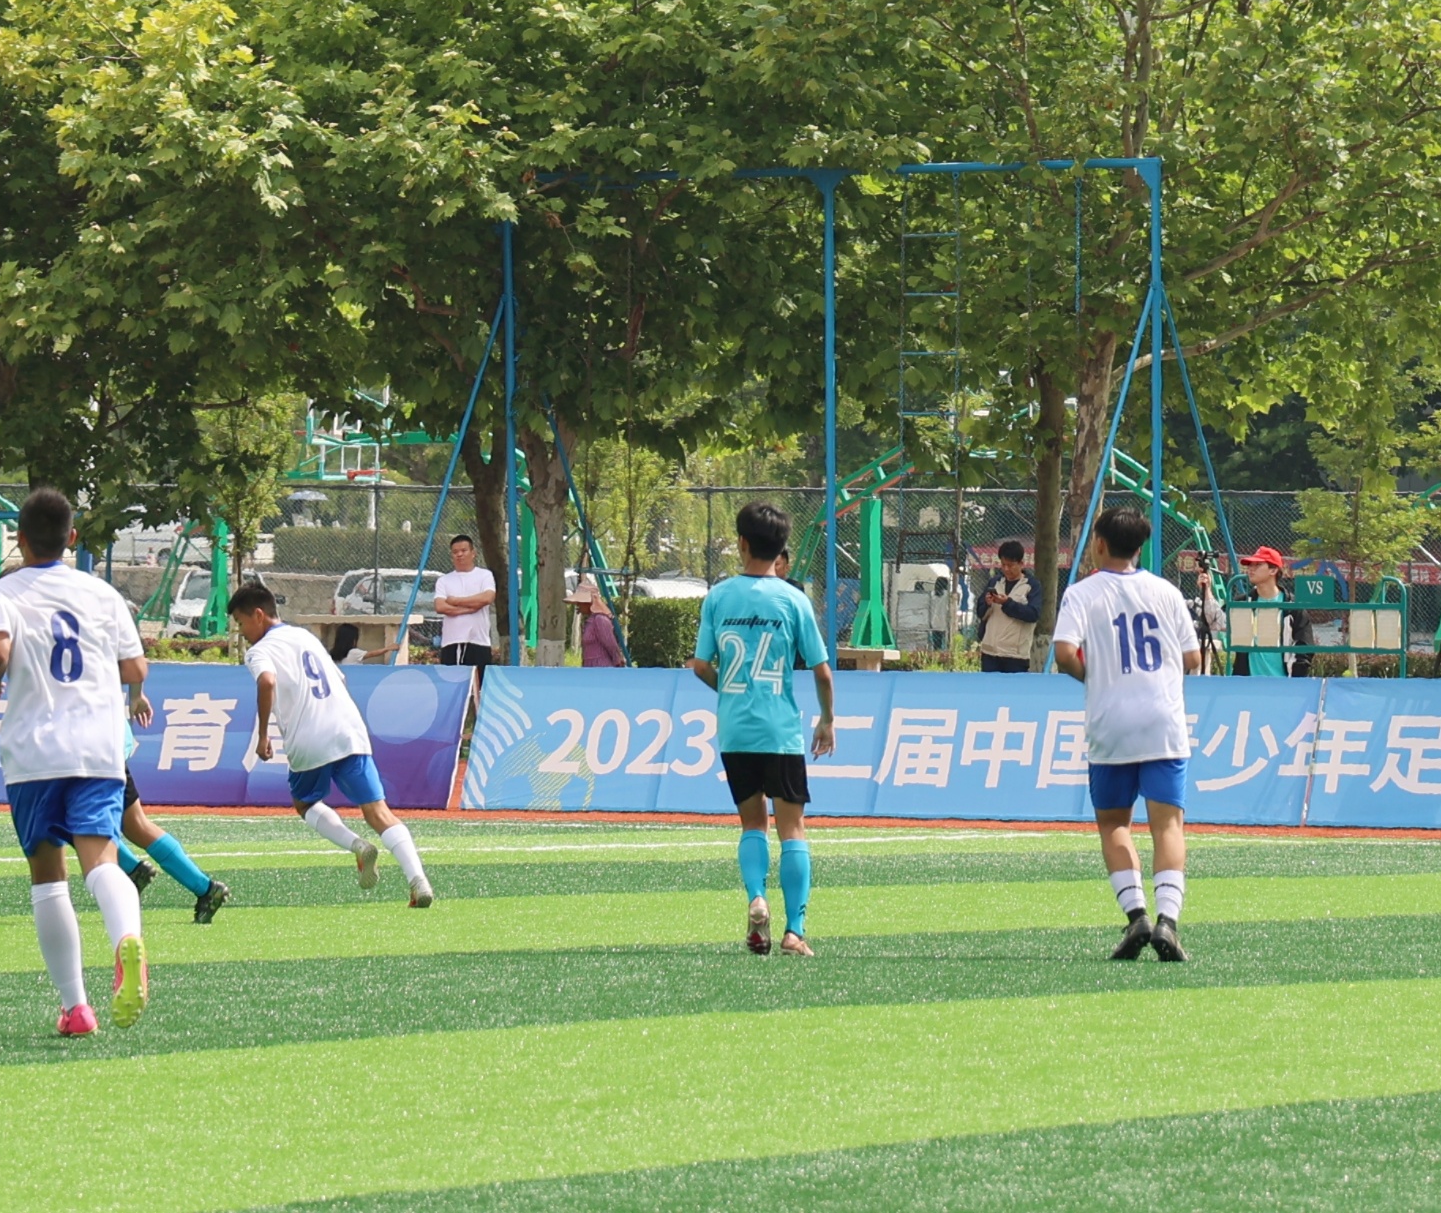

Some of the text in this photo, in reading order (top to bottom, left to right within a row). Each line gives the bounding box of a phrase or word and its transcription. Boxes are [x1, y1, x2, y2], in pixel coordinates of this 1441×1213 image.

[1306, 580, 1324, 595] VS
[50, 610, 83, 683] 8
[301, 650, 331, 700] 9
[719, 630, 786, 696] 24
[1112, 611, 1163, 675] 16
